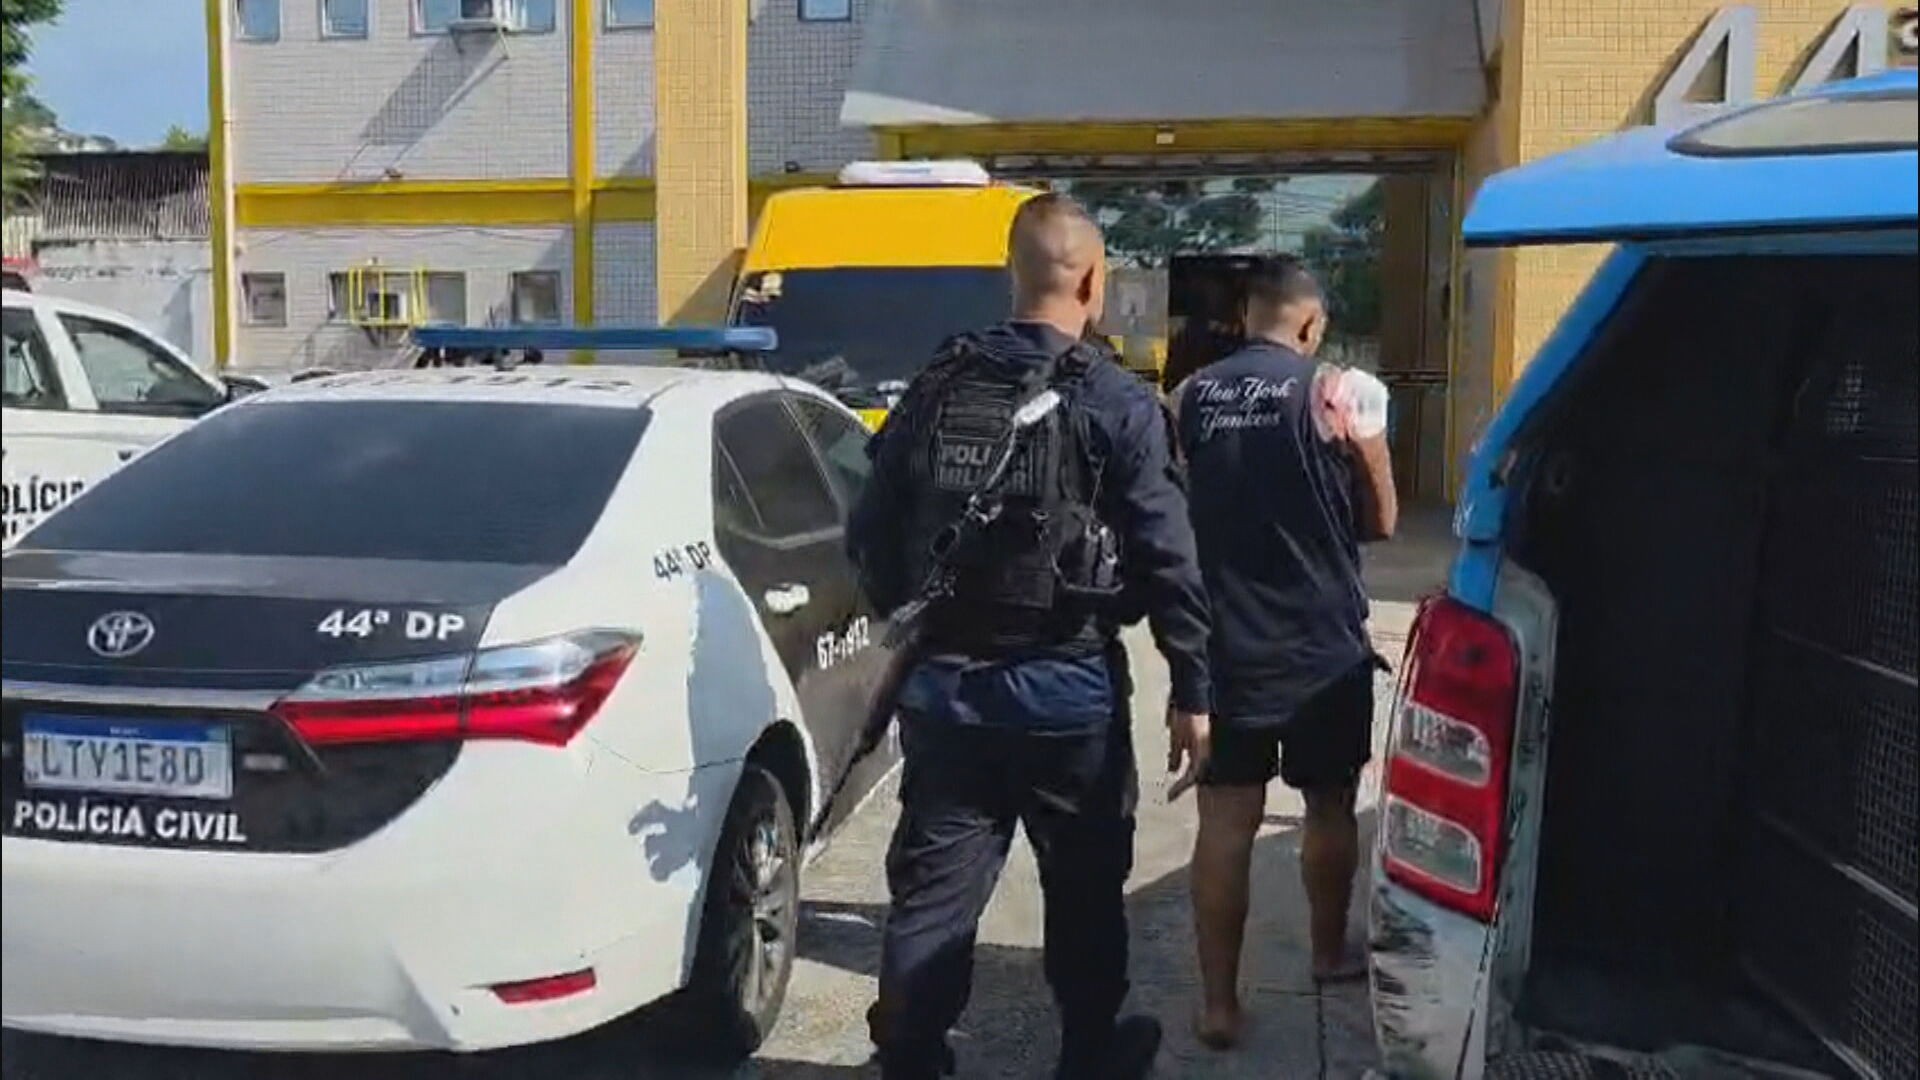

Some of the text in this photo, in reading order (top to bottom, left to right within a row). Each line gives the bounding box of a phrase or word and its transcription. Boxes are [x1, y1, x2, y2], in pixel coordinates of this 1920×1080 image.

[1196, 377, 1297, 409] New York
[686, 541, 711, 568] DP
[317, 608, 465, 640] 44ª DP
[13, 797, 247, 841] POLÍCIA CIVIL
